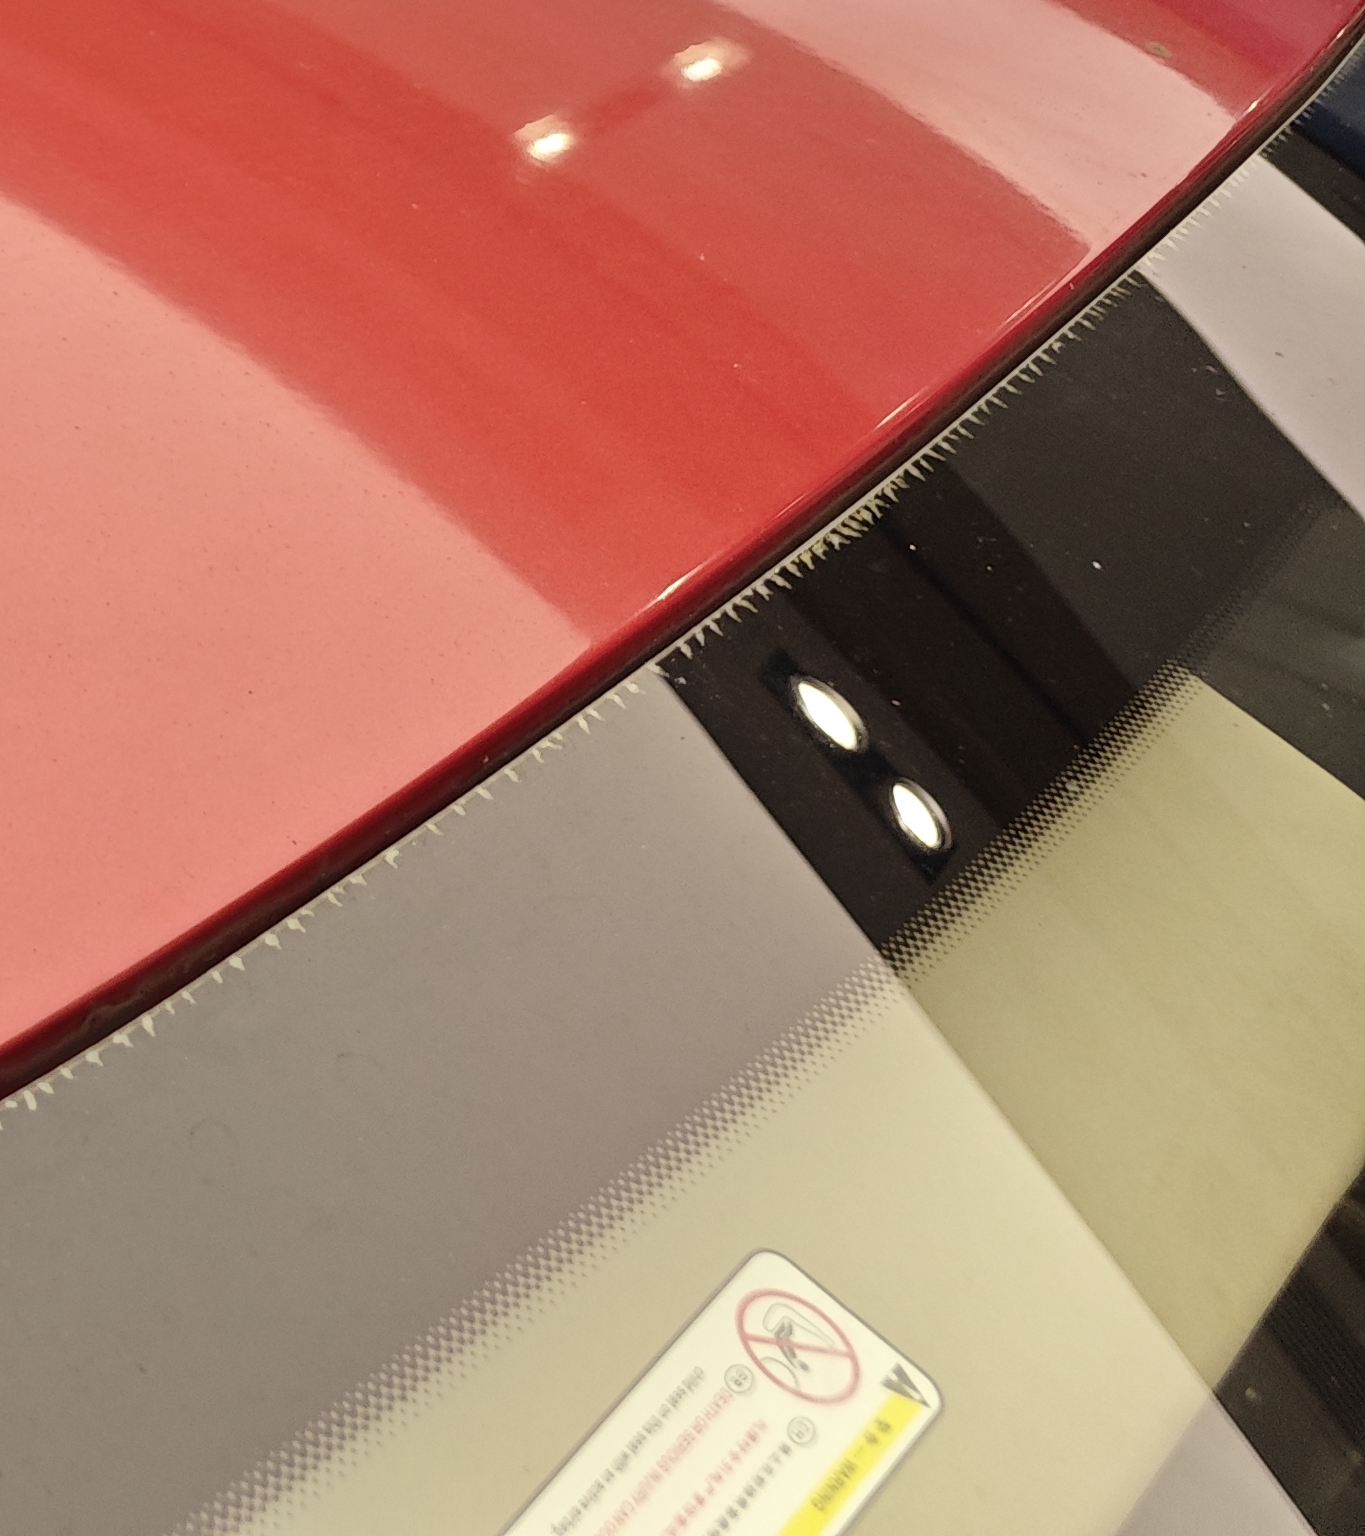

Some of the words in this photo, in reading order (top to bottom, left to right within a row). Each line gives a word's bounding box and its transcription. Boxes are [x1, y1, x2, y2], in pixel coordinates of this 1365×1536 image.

[688, 1413, 710, 1436] OR
[700, 1385, 734, 1422] DEATH
[655, 1426, 698, 1475] SERIOUS
[626, 1465, 664, 1507] INJURY
[808, 1456, 859, 1514] WARNING
